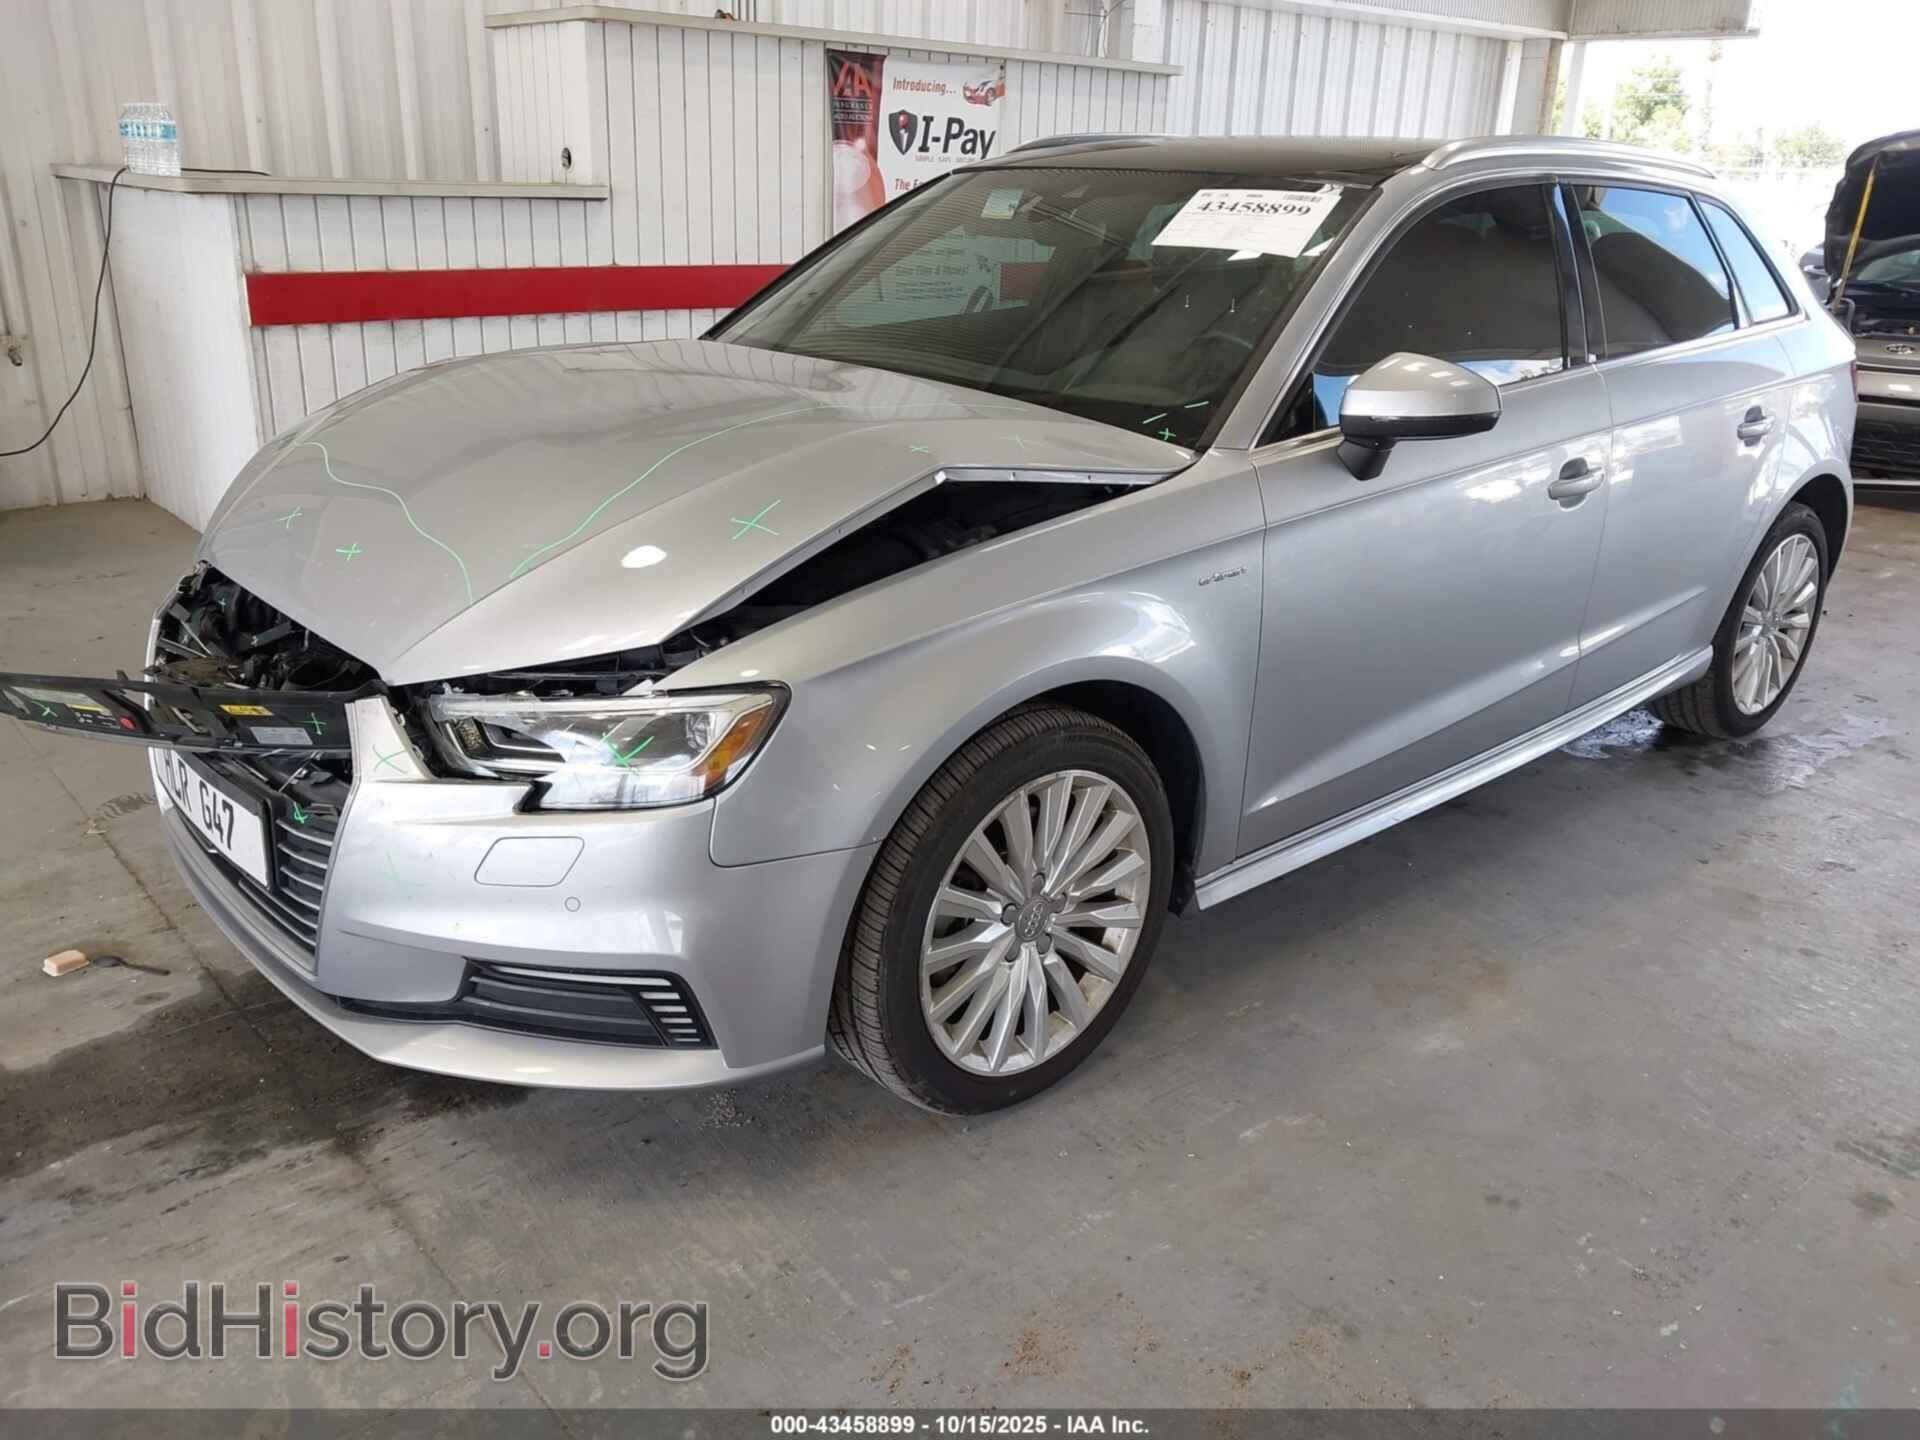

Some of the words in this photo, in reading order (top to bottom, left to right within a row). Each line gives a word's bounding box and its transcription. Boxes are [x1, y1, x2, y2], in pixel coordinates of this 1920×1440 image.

[893, 77, 957, 96] Introducing...
[918, 115, 996, 159] I-Pay
[894, 178, 911, 191] The
[1197, 200, 1312, 216] 43458899
